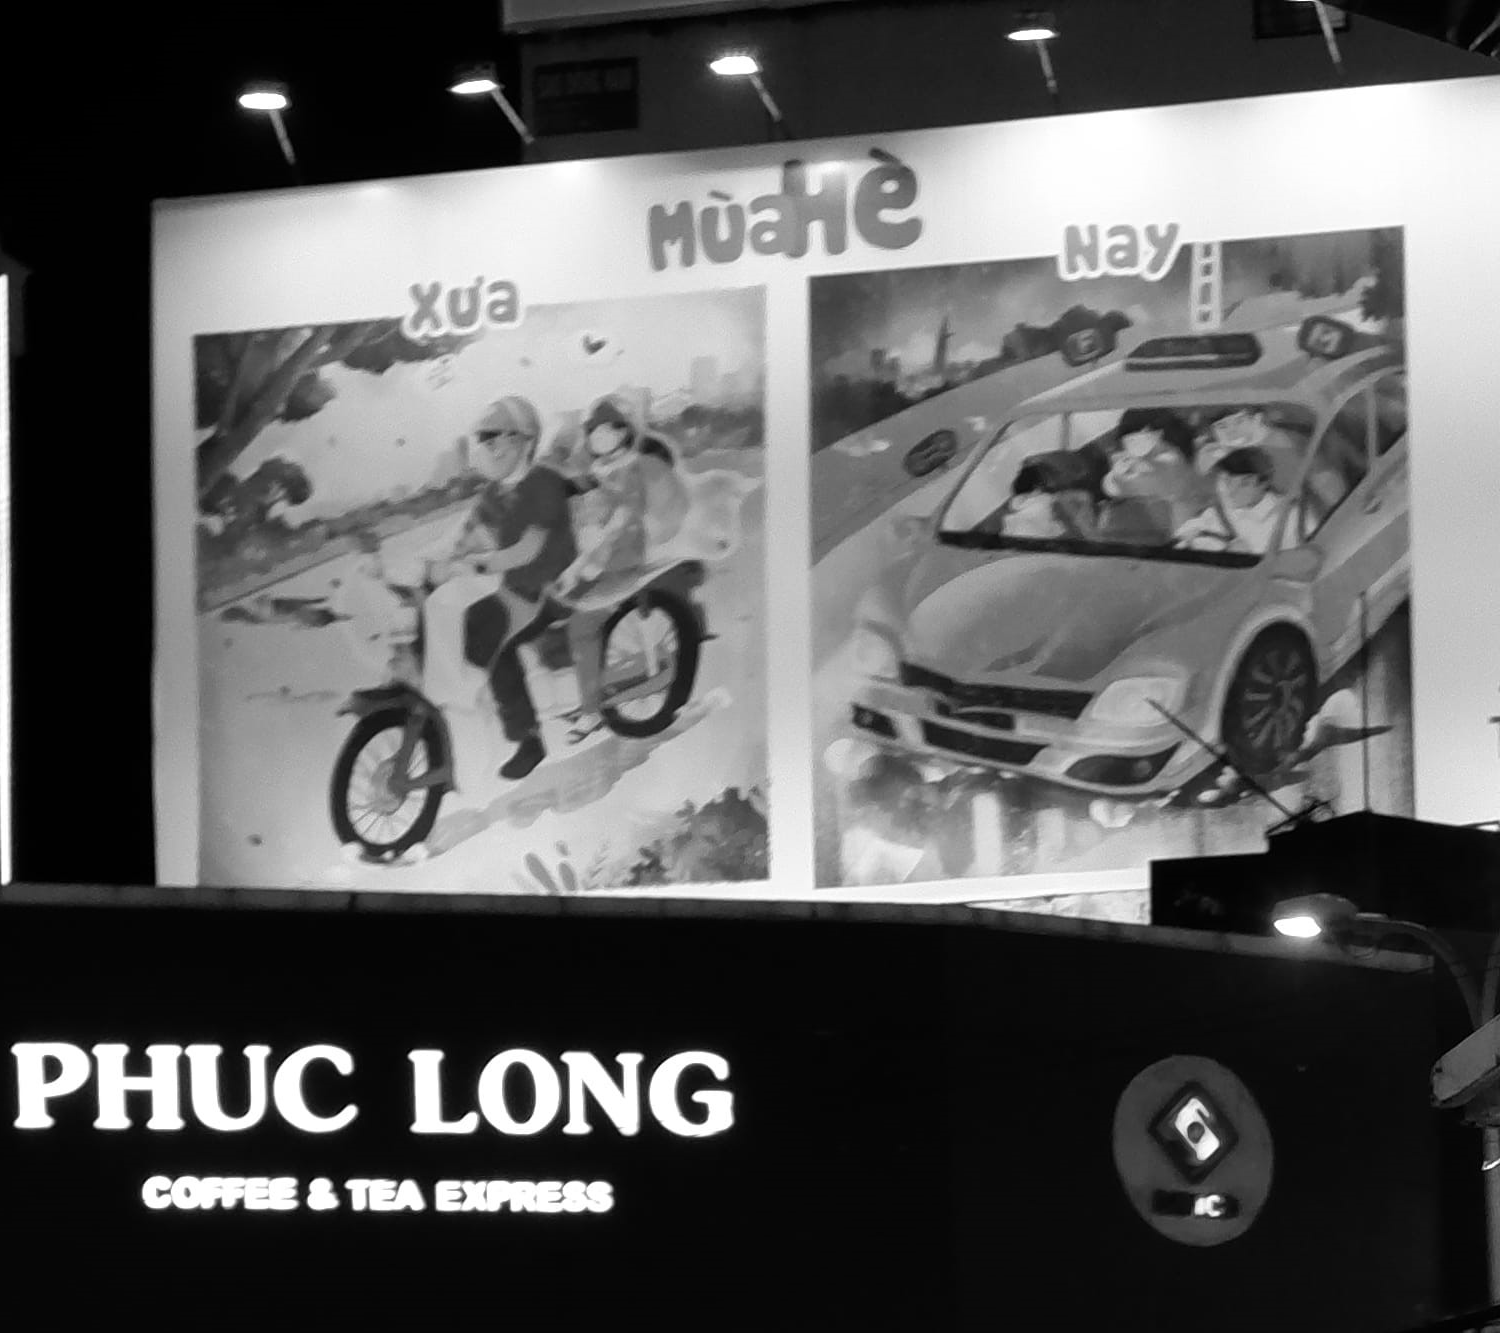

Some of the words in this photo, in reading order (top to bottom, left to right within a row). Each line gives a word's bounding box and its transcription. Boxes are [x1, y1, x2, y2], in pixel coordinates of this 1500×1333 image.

[10, 1041, 359, 1134] PHUC
[407, 1048, 735, 1137] LONG
[141, 1174, 299, 1212] COFFEE
[306, 1176, 339, 1212] &
[345, 1177, 425, 1213] TEA
[434, 1178, 616, 1215] EXPRESS
